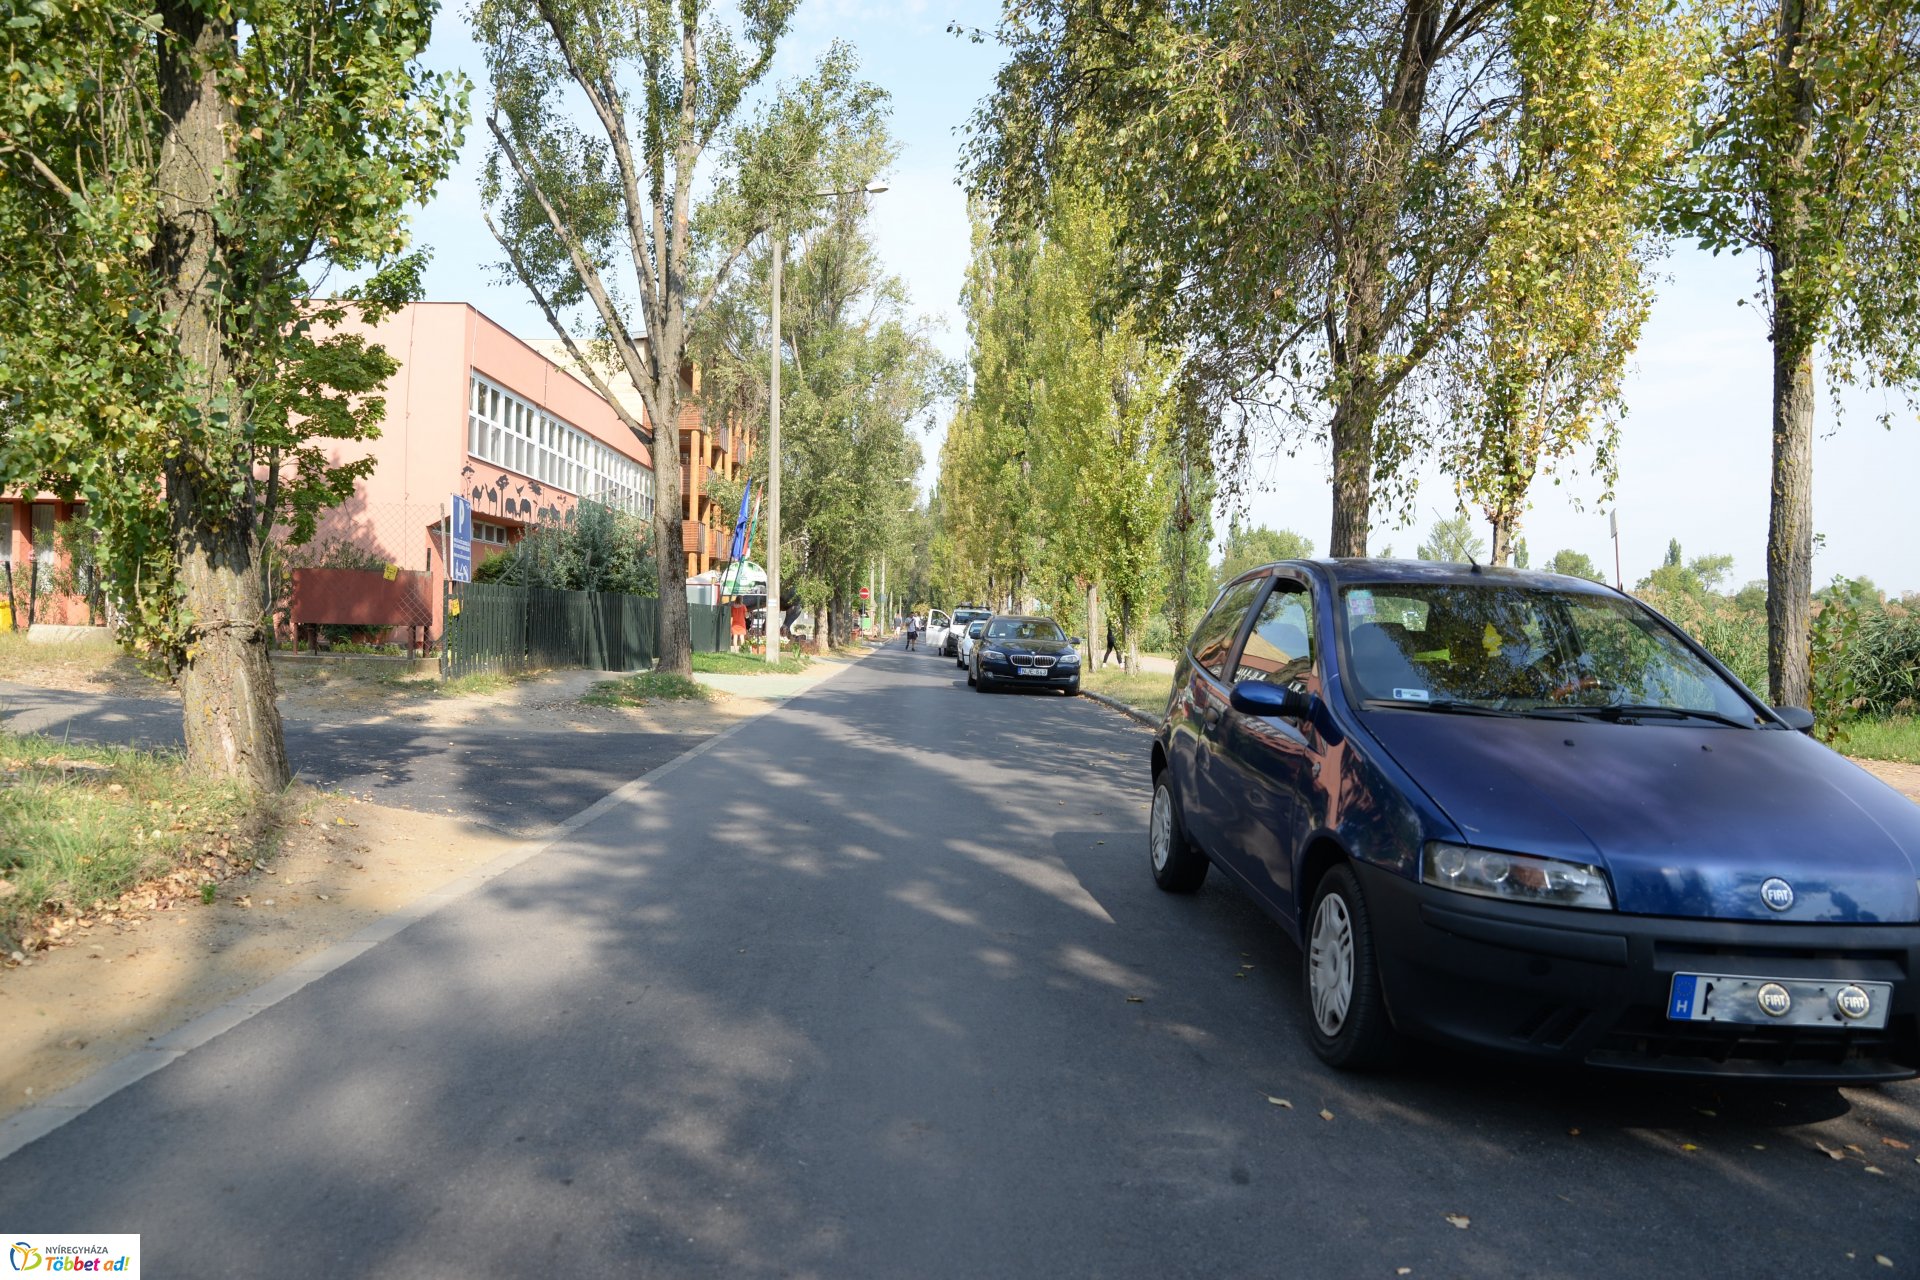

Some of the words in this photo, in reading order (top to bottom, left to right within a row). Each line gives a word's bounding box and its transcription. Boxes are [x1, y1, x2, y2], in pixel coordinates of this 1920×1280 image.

[458, 499, 465, 533] P
[1768, 889, 1788, 901] FIAT
[1765, 994, 1785, 1006] FIAT
[1843, 997, 1864, 1008] FIAT
[1676, 1000, 1688, 1013] H
